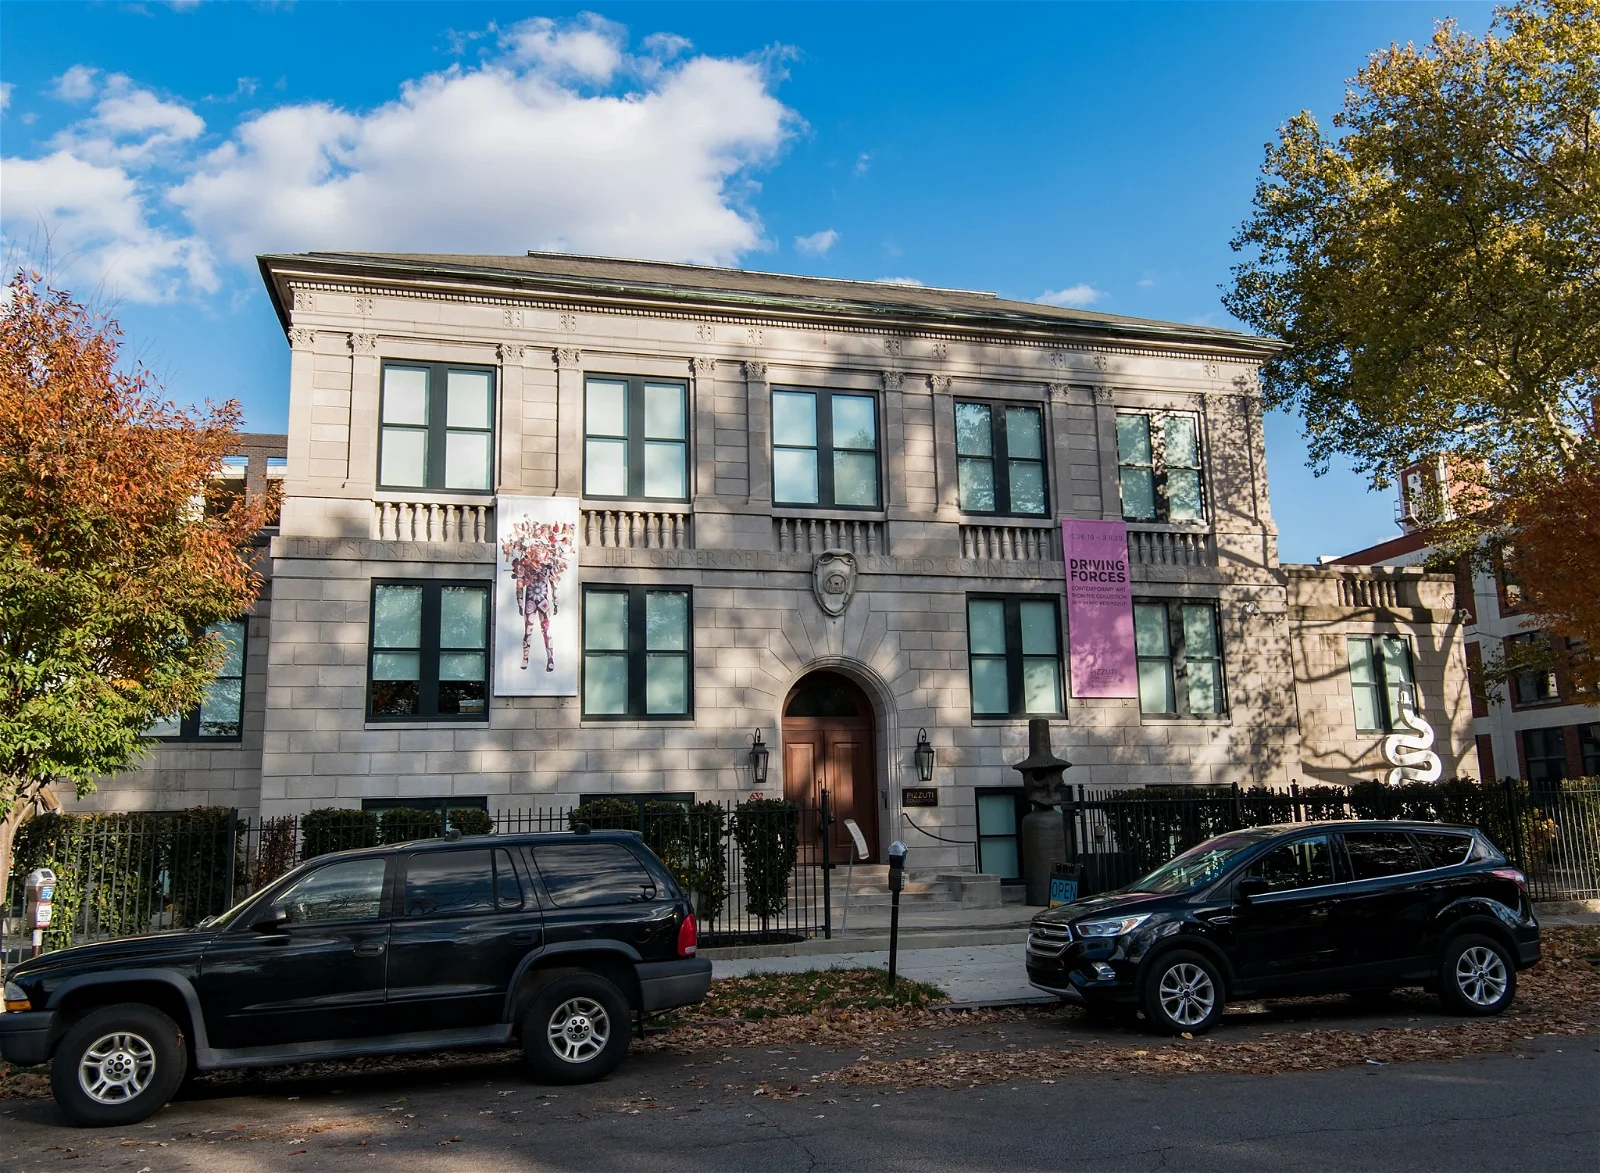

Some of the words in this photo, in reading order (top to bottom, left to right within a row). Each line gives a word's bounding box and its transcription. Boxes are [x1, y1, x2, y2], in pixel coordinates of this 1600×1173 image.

[291, 539, 334, 557] THE
[345, 540, 442, 561] SUPREME
[603, 549, 638, 564] THE
[649, 550, 718, 567] ORDER
[727, 551, 753, 567] OF
[865, 555, 934, 573] UNITED
[944, 558, 1065, 577] COMMERCIAL
[1069, 558, 1126, 571] DRIVING
[1070, 569, 1127, 583] FORCES
[750, 791, 764, 800] 632
[906, 791, 934, 799] PIZZUTI
[1051, 881, 1077, 901] OPEN
